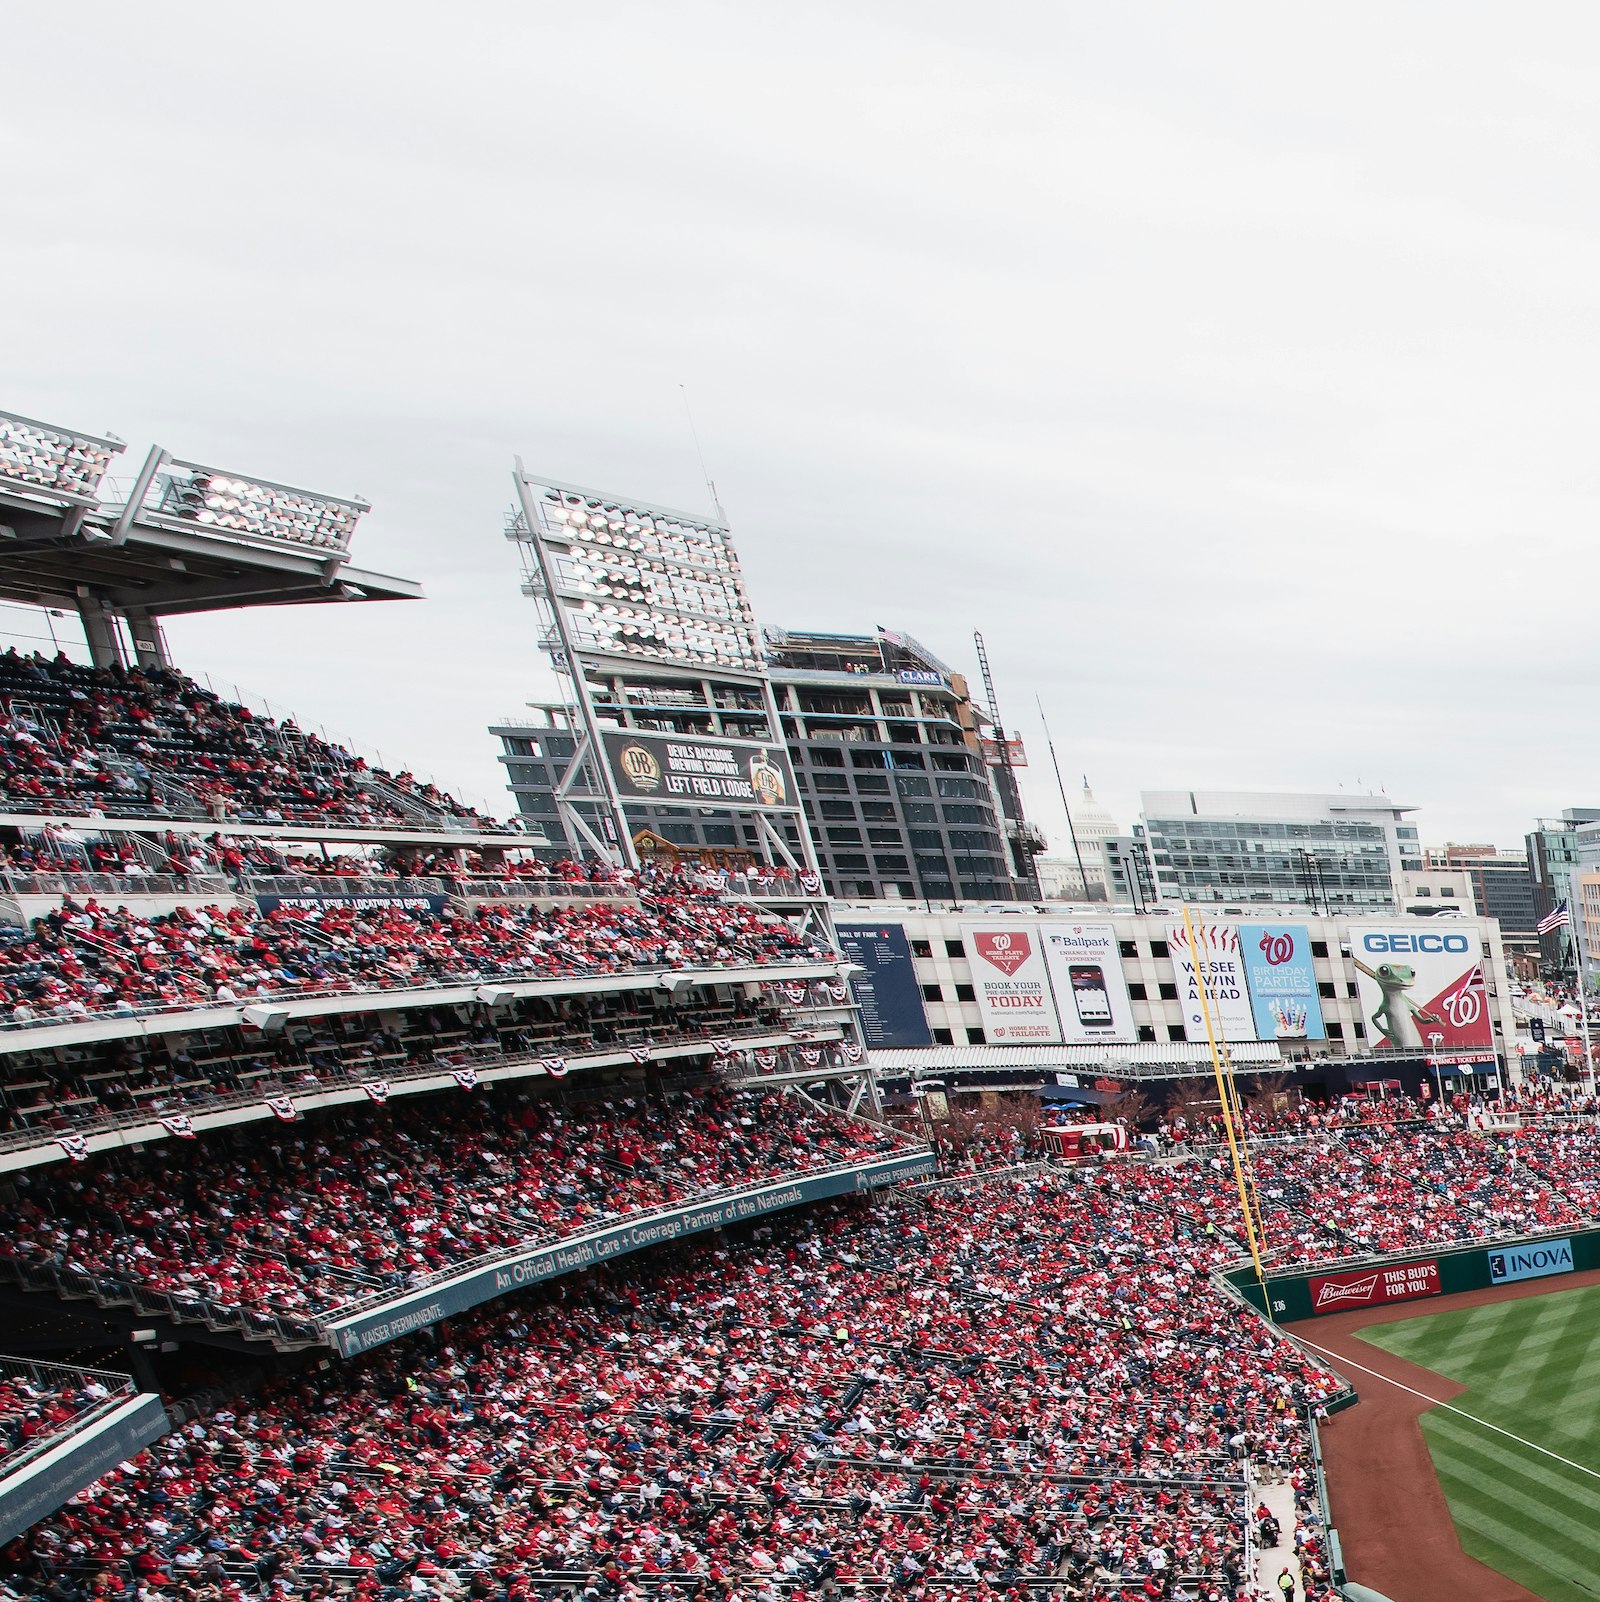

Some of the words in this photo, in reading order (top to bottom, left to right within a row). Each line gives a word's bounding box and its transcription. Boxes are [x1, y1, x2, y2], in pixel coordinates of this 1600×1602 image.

[666, 744, 695, 760] DEVILS
[696, 747, 735, 763] BACKBONE
[668, 757, 705, 773] BREWING
[704, 761, 740, 776] COMPANY
[665, 775, 691, 793] LEFT
[692, 777, 720, 796] FIELD
[721, 780, 755, 799] LODGE
[1063, 937, 1110, 947] Ballpark
[1363, 933, 1469, 953] GEICO
[1209, 961, 1236, 973] SEE
[1253, 966, 1307, 976] BIRTHDAY
[984, 982, 1012, 990] BOOK
[1013, 982, 1041, 990] YOUR
[1202, 975, 1236, 986] WIN
[1254, 976, 1311, 988] PARTIES
[987, 995, 1043, 1008] TODAY
[495, 1271, 512, 1289] An
[513, 1254, 557, 1284] Official
[556, 1244, 595, 1270] Health
[595, 1238, 620, 1256] Care
[631, 1221, 682, 1246] Coverage
[682, 1210, 723, 1230] Partner
[726, 1203, 737, 1219] of
[739, 1200, 756, 1216] the
[757, 1186, 803, 1210] Nationals
[1510, 1247, 1572, 1272] INOVA
[1383, 1270, 1406, 1283] THIS
[1408, 1264, 1437, 1280] BUD'S
[1321, 1283, 1373, 1301] Budweiser
[1385, 1283, 1407, 1296] FOR
[1408, 1278, 1430, 1293] YOU.
[1272, 1300, 1286, 1313] 336
[361, 1325, 390, 1348] KAISER
[391, 1303, 444, 1341] PERMANENTE
